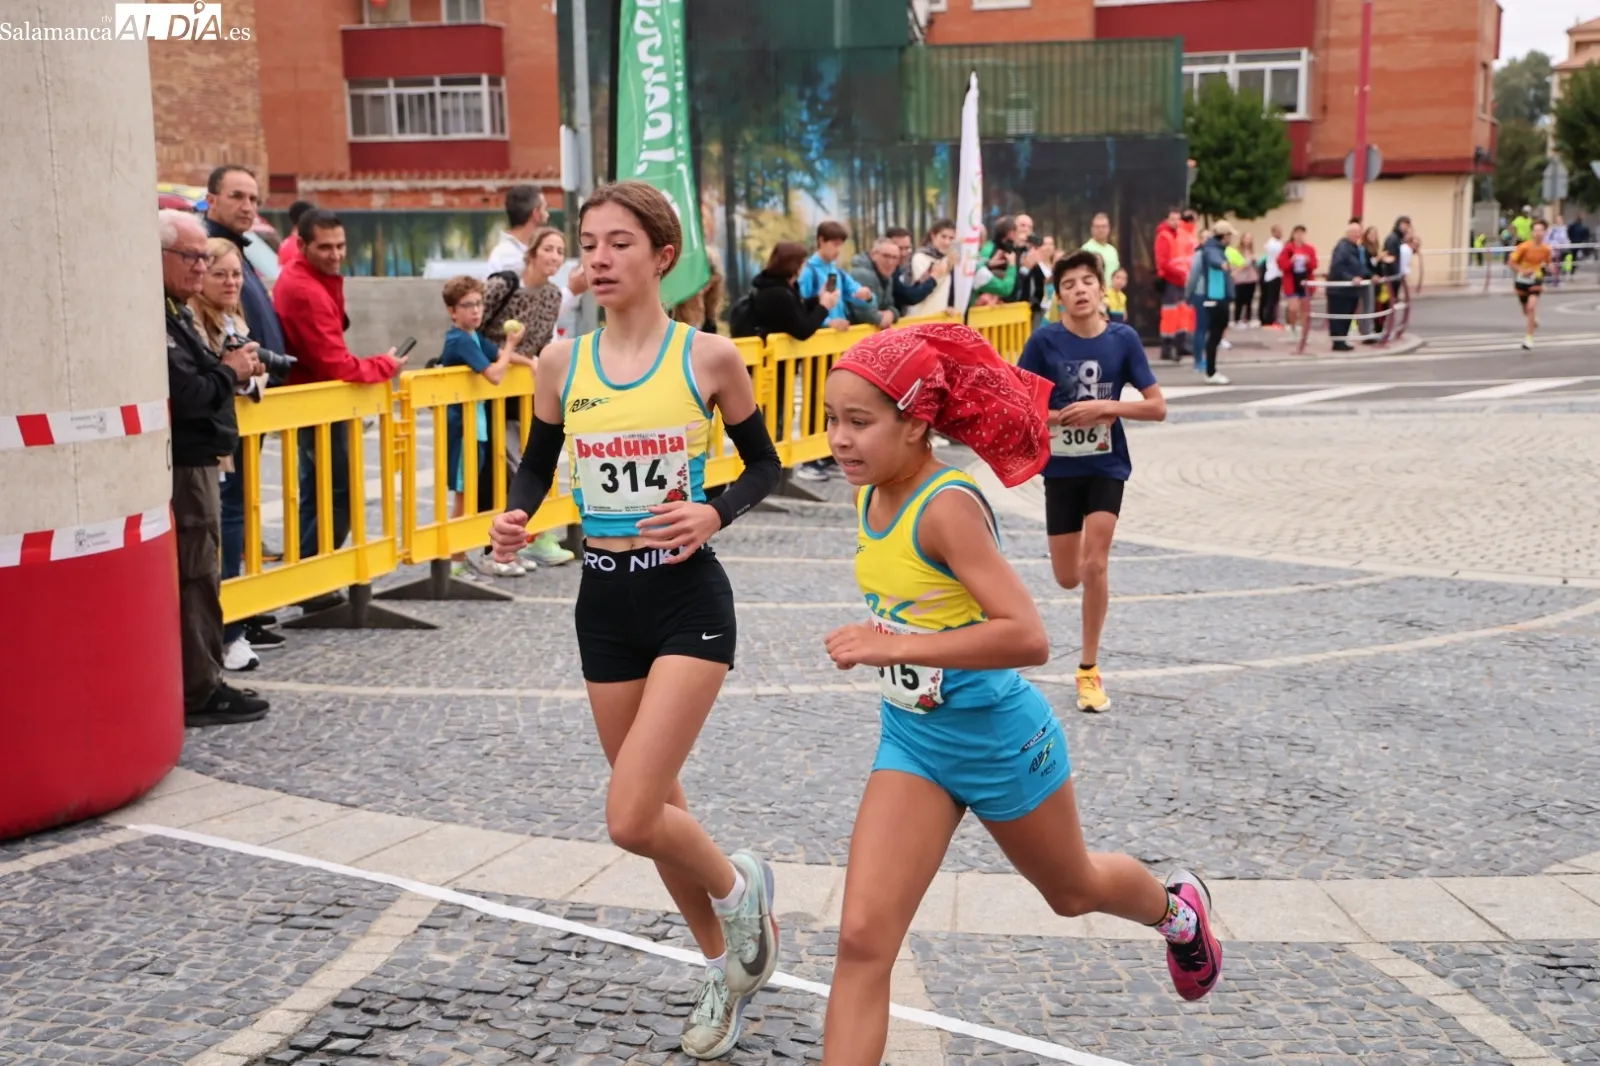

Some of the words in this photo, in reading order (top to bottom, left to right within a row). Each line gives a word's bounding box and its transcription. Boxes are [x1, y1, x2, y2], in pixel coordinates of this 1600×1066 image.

[575, 434, 685, 459] bedunia
[1062, 428, 1098, 445] 306
[599, 458, 668, 493] 314
[583, 551, 616, 572] RO
[629, 545, 685, 572] NIK
